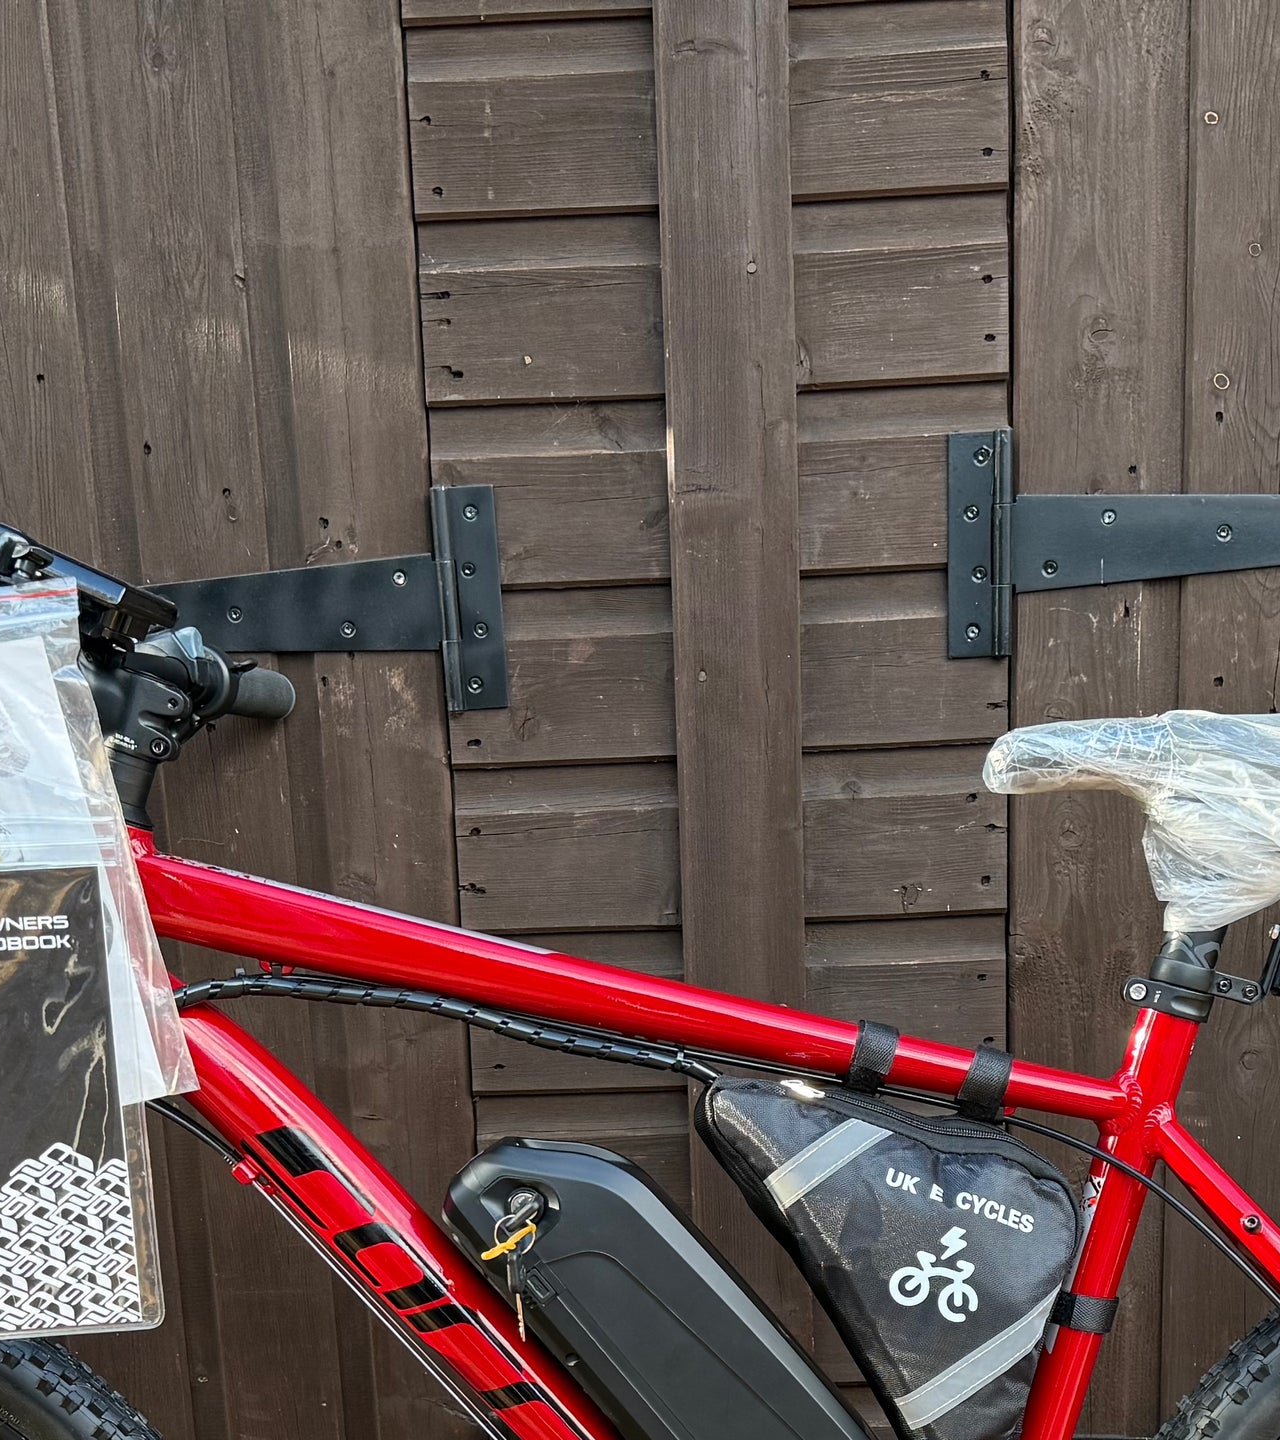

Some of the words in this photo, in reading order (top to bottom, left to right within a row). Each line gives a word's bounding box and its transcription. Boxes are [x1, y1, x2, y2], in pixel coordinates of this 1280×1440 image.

[885, 1167, 921, 1195] UK
[929, 1183, 944, 1203] E
[955, 1191, 1035, 1233] CYCLES
